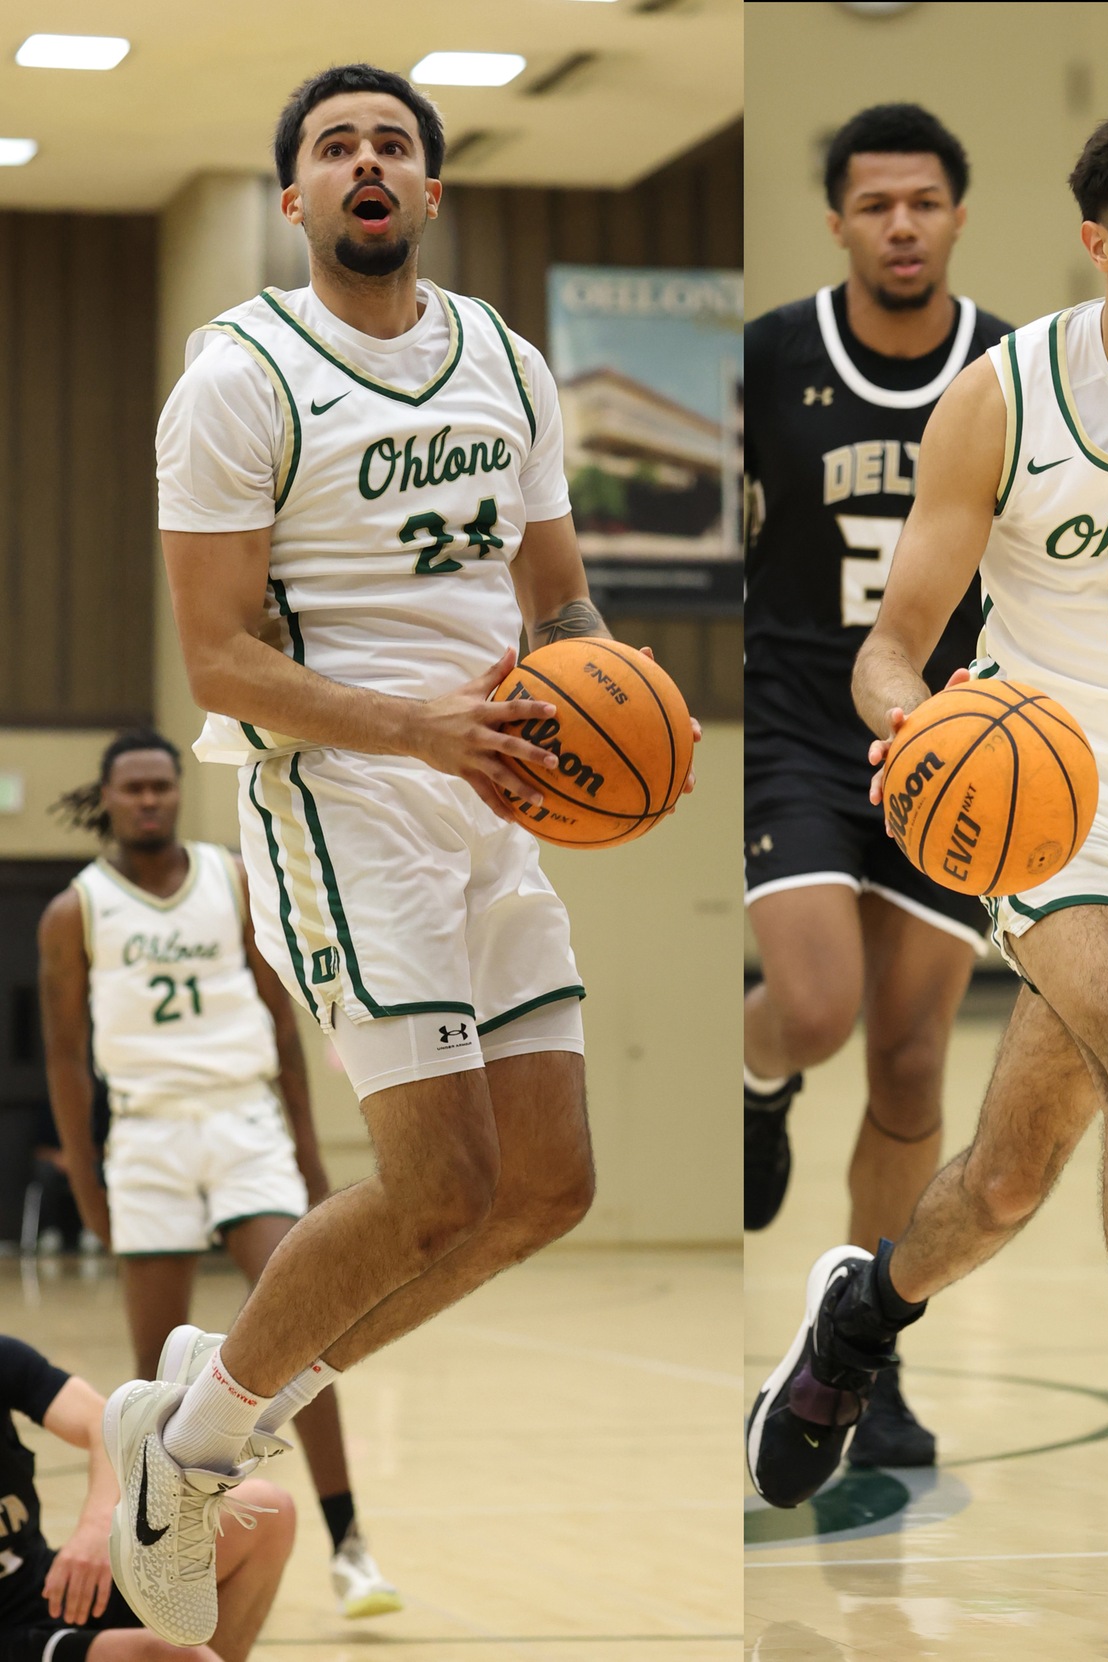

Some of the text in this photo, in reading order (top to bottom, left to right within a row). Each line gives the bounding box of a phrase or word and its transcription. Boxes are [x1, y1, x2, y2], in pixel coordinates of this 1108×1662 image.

[358, 425, 511, 500] Ohlone
[822, 439, 922, 506] DELT
[396, 494, 505, 575] 24
[590, 665, 629, 706] NFHS
[960, 783, 978, 812] NXT
[147, 974, 203, 1025] 21
